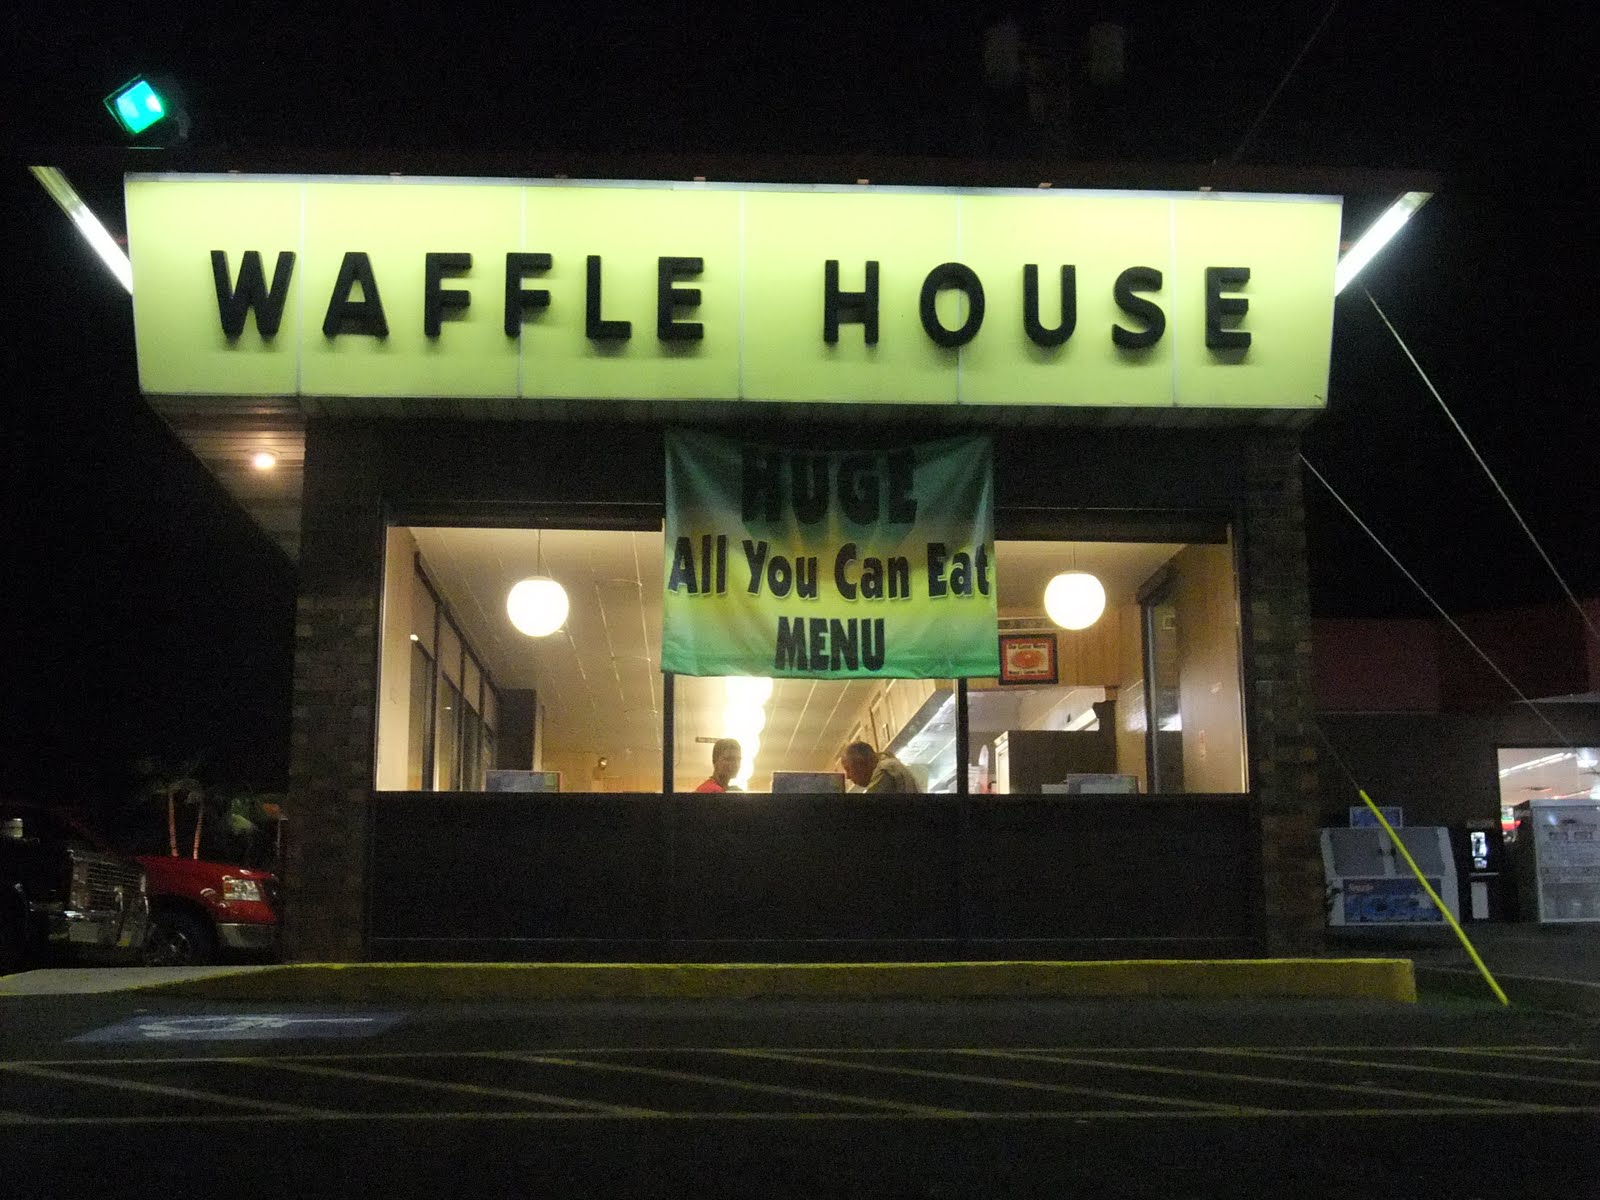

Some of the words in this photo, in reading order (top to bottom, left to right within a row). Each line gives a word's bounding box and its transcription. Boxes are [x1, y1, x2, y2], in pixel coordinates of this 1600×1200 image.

[210, 250, 704, 340] WAFFLE
[823, 259, 1252, 350] HOUSE
[742, 448, 918, 525] HUGE
[667, 534, 728, 595] All
[742, 539, 818, 600] You
[834, 542, 911, 600] Can
[927, 542, 992, 598] Eat
[774, 615, 886, 672] MENU
